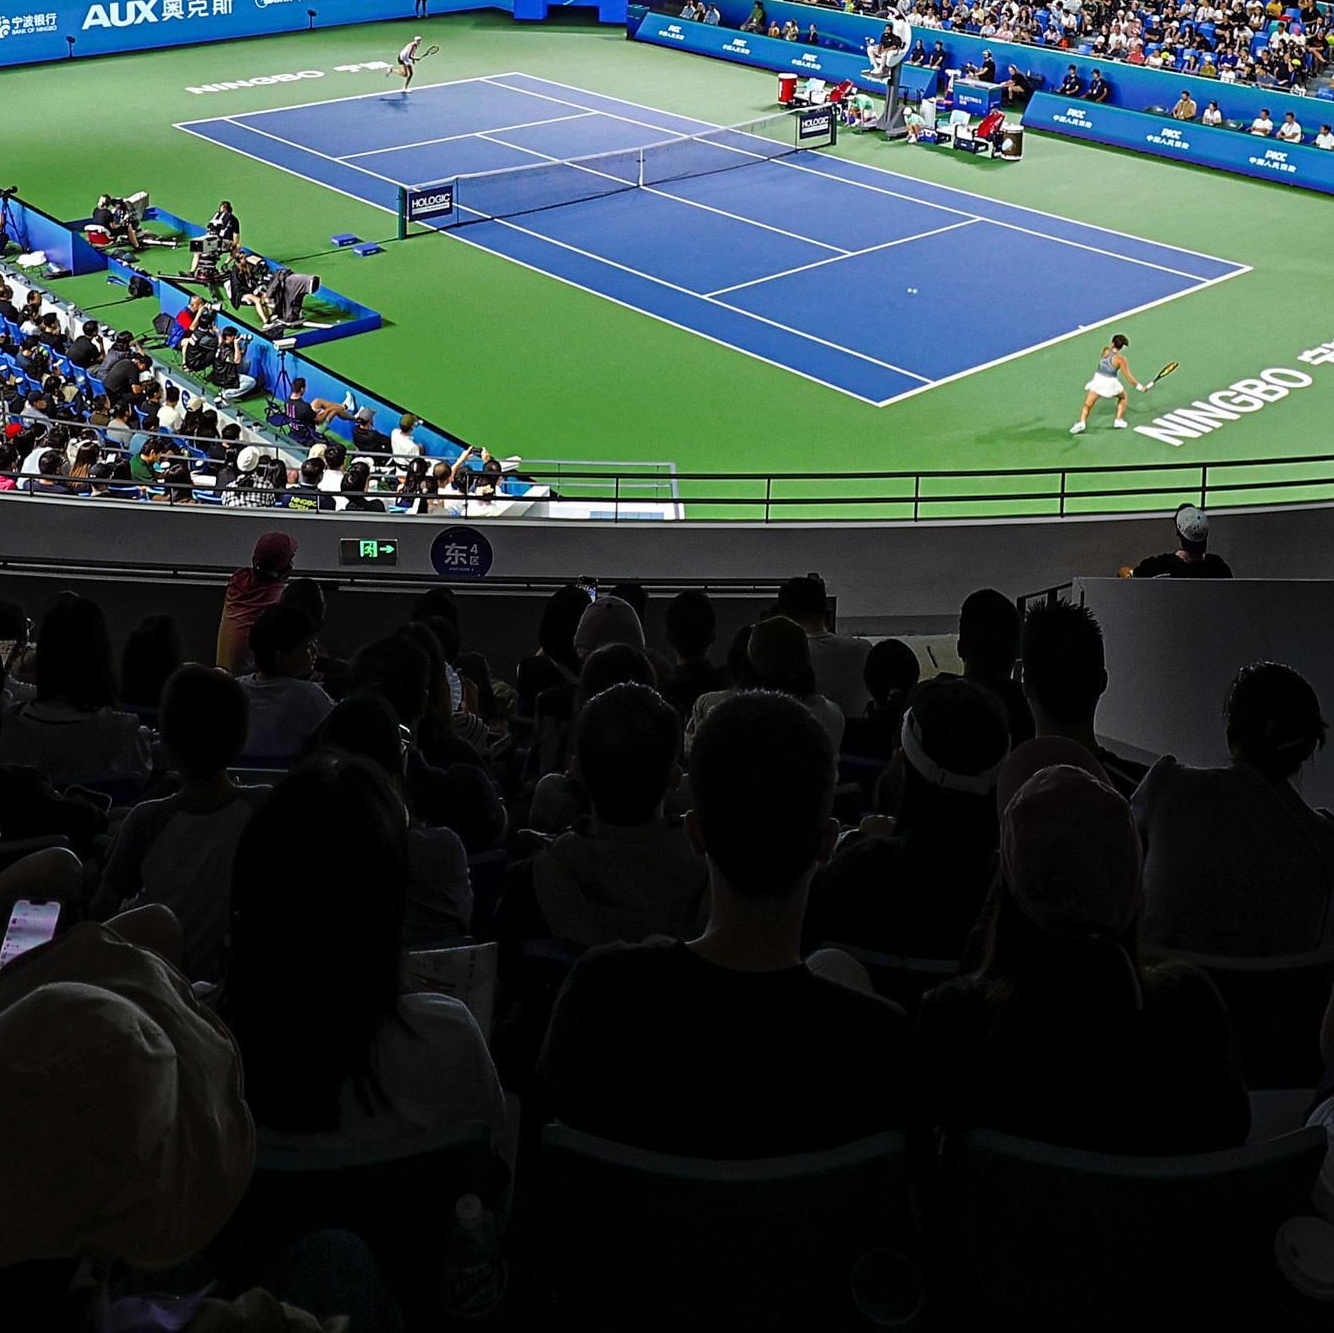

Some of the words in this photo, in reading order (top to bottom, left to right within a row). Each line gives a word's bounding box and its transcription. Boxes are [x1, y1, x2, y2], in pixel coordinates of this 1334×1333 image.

[11, 13, 57, 30] 宁波银行
[185, 70, 325, 95] NINGBO
[1067, 108, 1087, 119] PICC
[1161, 128, 1182, 139] PICC
[1265, 149, 1288, 162] PICC
[411, 193, 451, 209] HOLOGIC
[1133, 367, 1313, 447] NINGBO
[444, 542, 468, 565] 东
[470, 543, 478, 555] 4
[469, 555, 480, 566] 区
